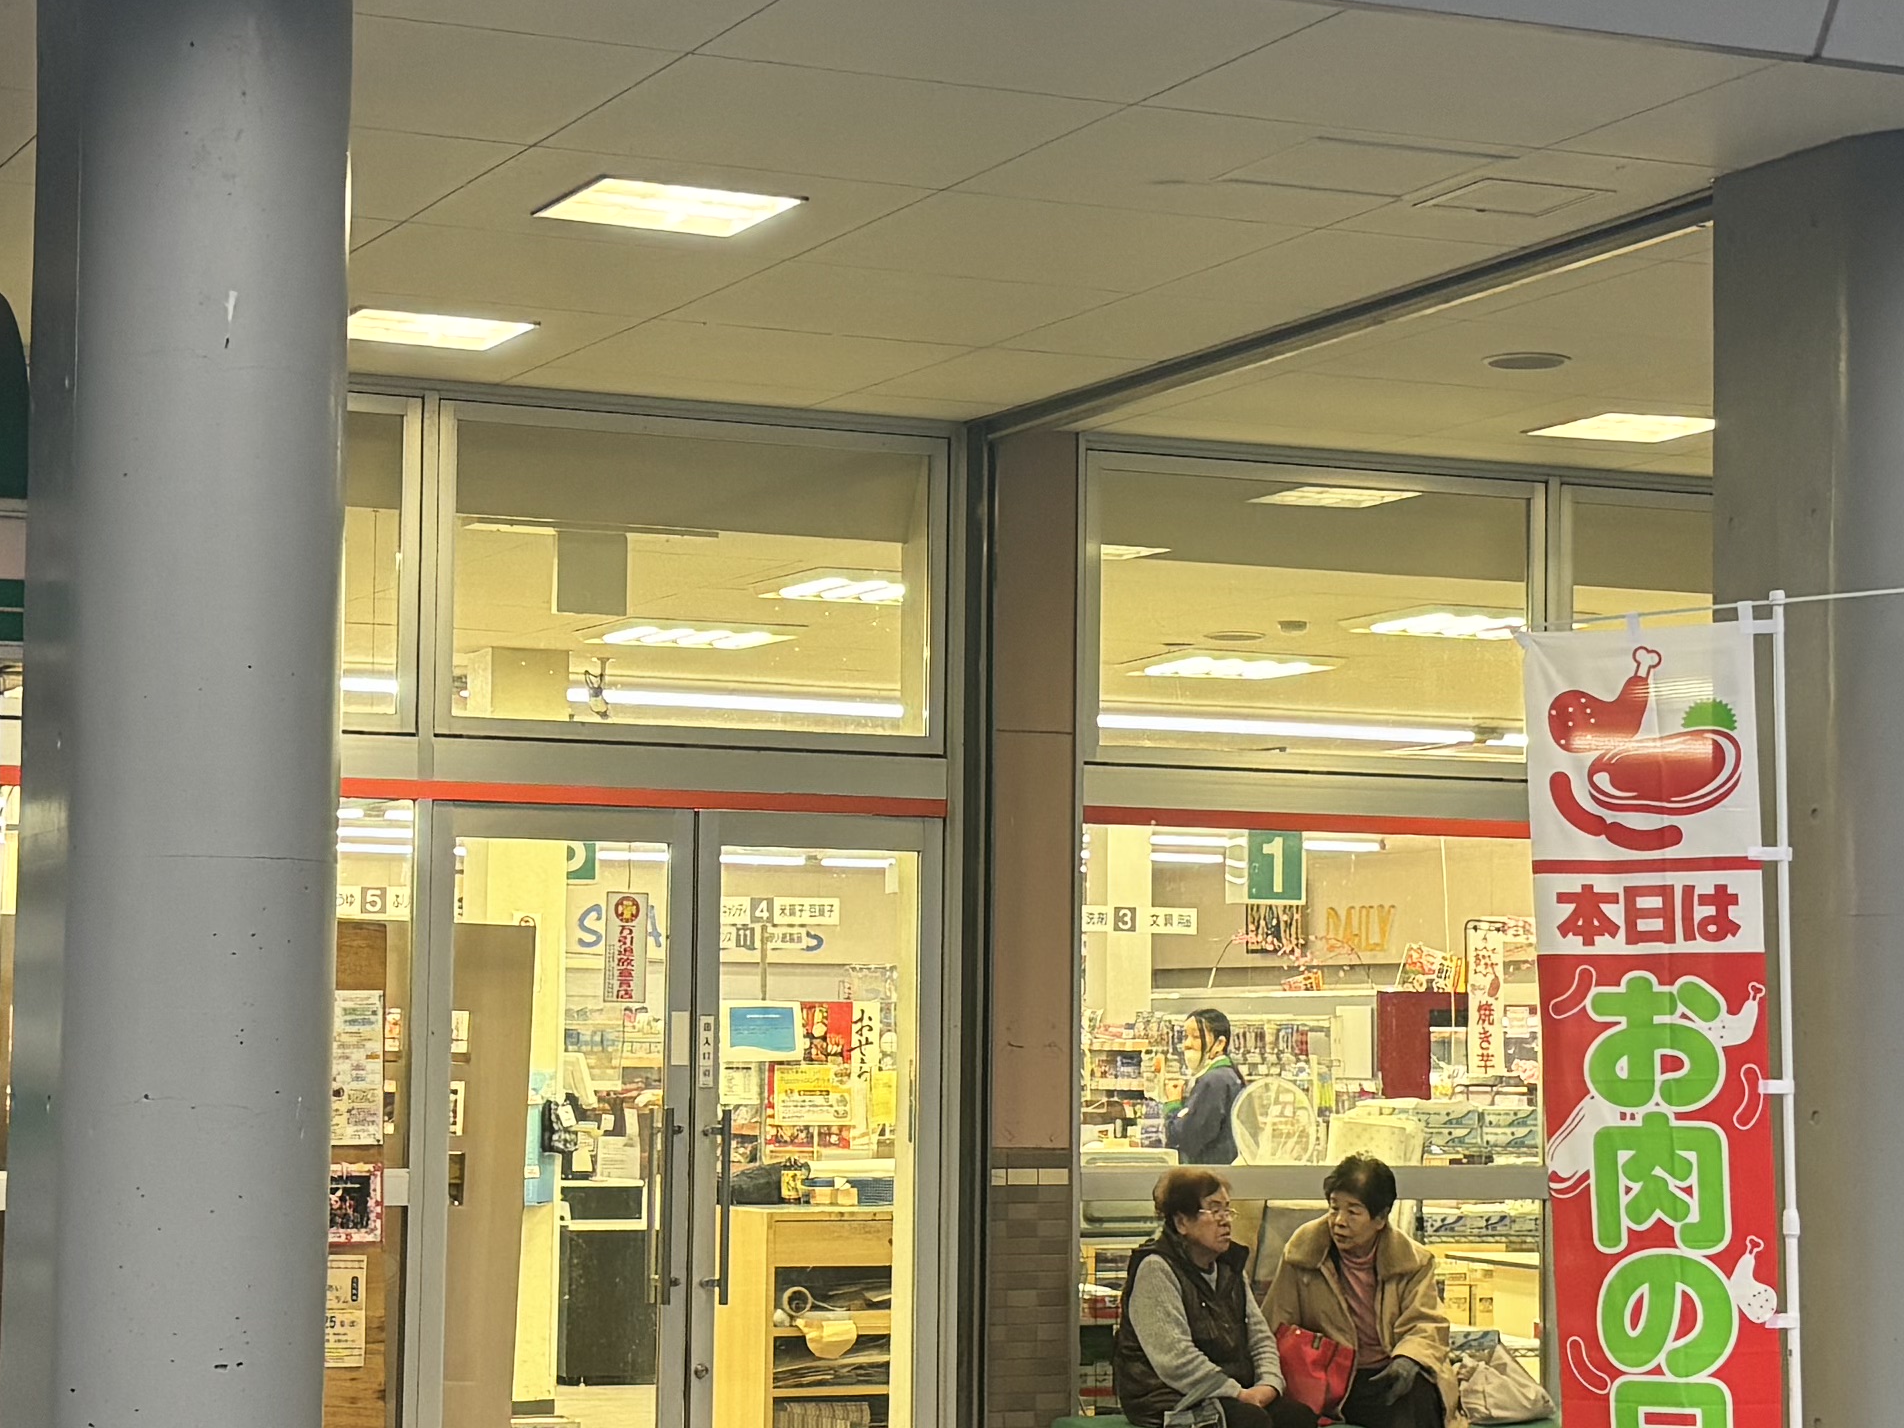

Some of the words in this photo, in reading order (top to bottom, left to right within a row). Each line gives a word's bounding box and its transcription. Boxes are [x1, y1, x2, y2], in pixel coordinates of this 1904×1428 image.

[1262, 836, 1284, 893] 1
[365, 889, 383, 913] 5
[754, 899, 770, 920] 4
[1118, 908, 1132, 930] 3
[1555, 882, 1742, 947] 本日は
[615, 924, 636, 1000] 万引追放宣言店
[1476, 1000, 1496, 1075] 焼き芋
